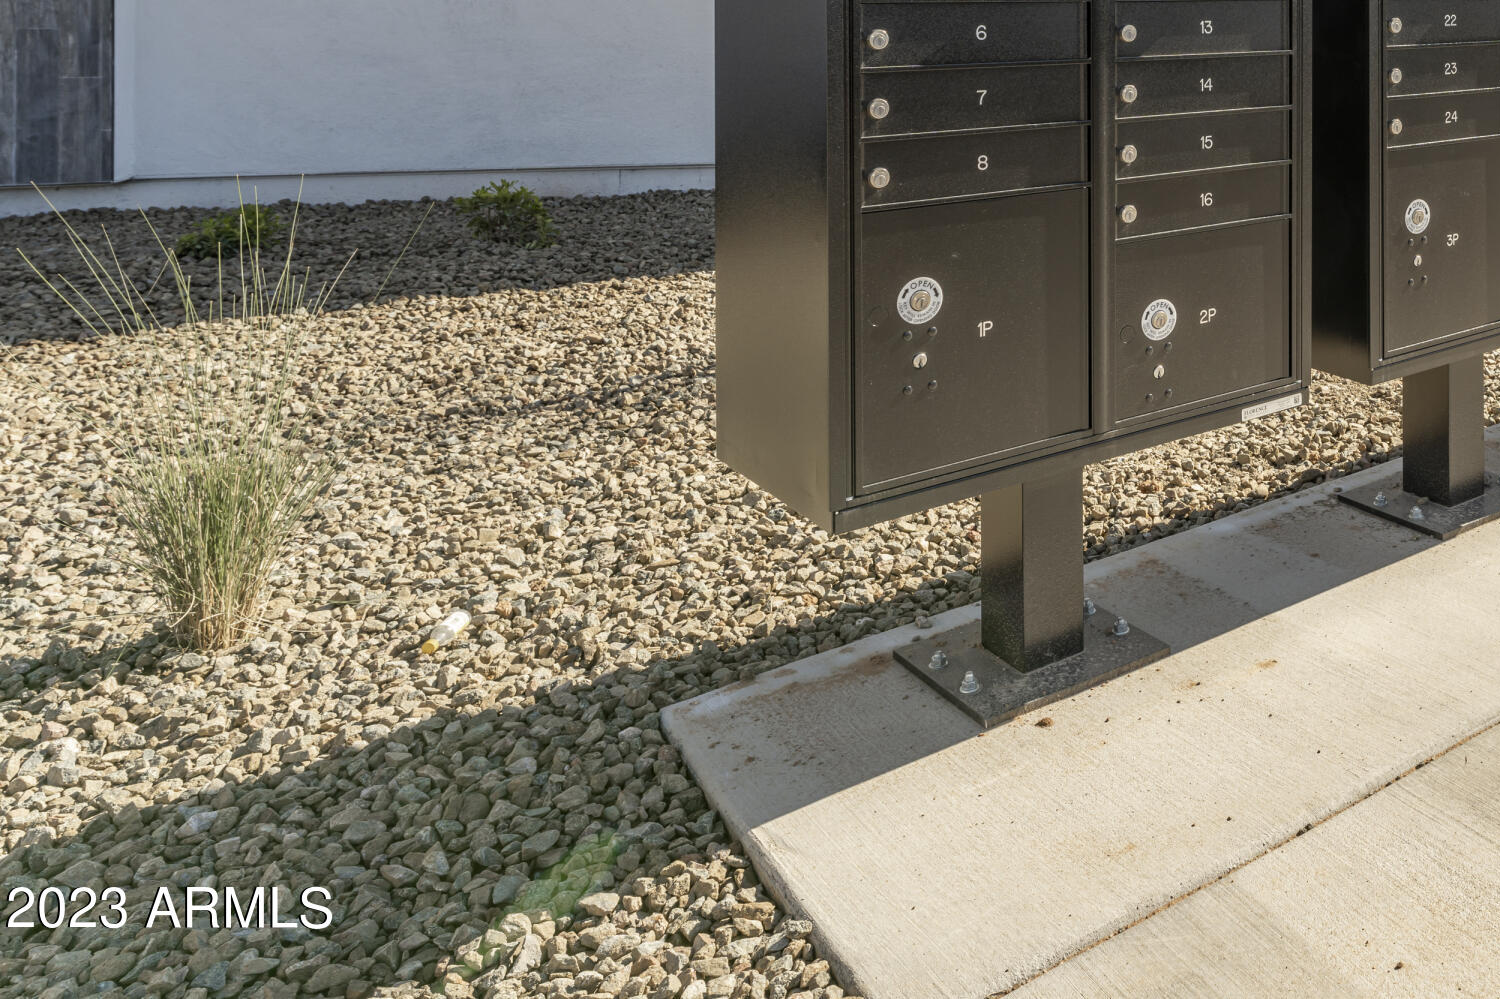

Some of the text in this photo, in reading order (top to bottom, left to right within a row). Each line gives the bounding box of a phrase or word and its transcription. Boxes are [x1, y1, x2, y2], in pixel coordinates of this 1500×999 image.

[1199, 20, 1213, 35] 13
[1444, 14, 1457, 27] 22
[975, 24, 988, 41] 6
[1444, 62, 1458, 75] 23
[1199, 77, 1214, 92] 14
[976, 89, 988, 106] 7
[1444, 110, 1458, 124] 24
[1200, 135, 1214, 150] 15
[977, 154, 989, 171] 8
[1199, 192, 1213, 207] 16
[1446, 232, 1459, 247] 3P
[910, 280, 934, 289] OPEN
[1150, 301, 1168, 311] OPEN
[1199, 307, 1217, 325] 2P
[977, 320, 994, 338] 1P
